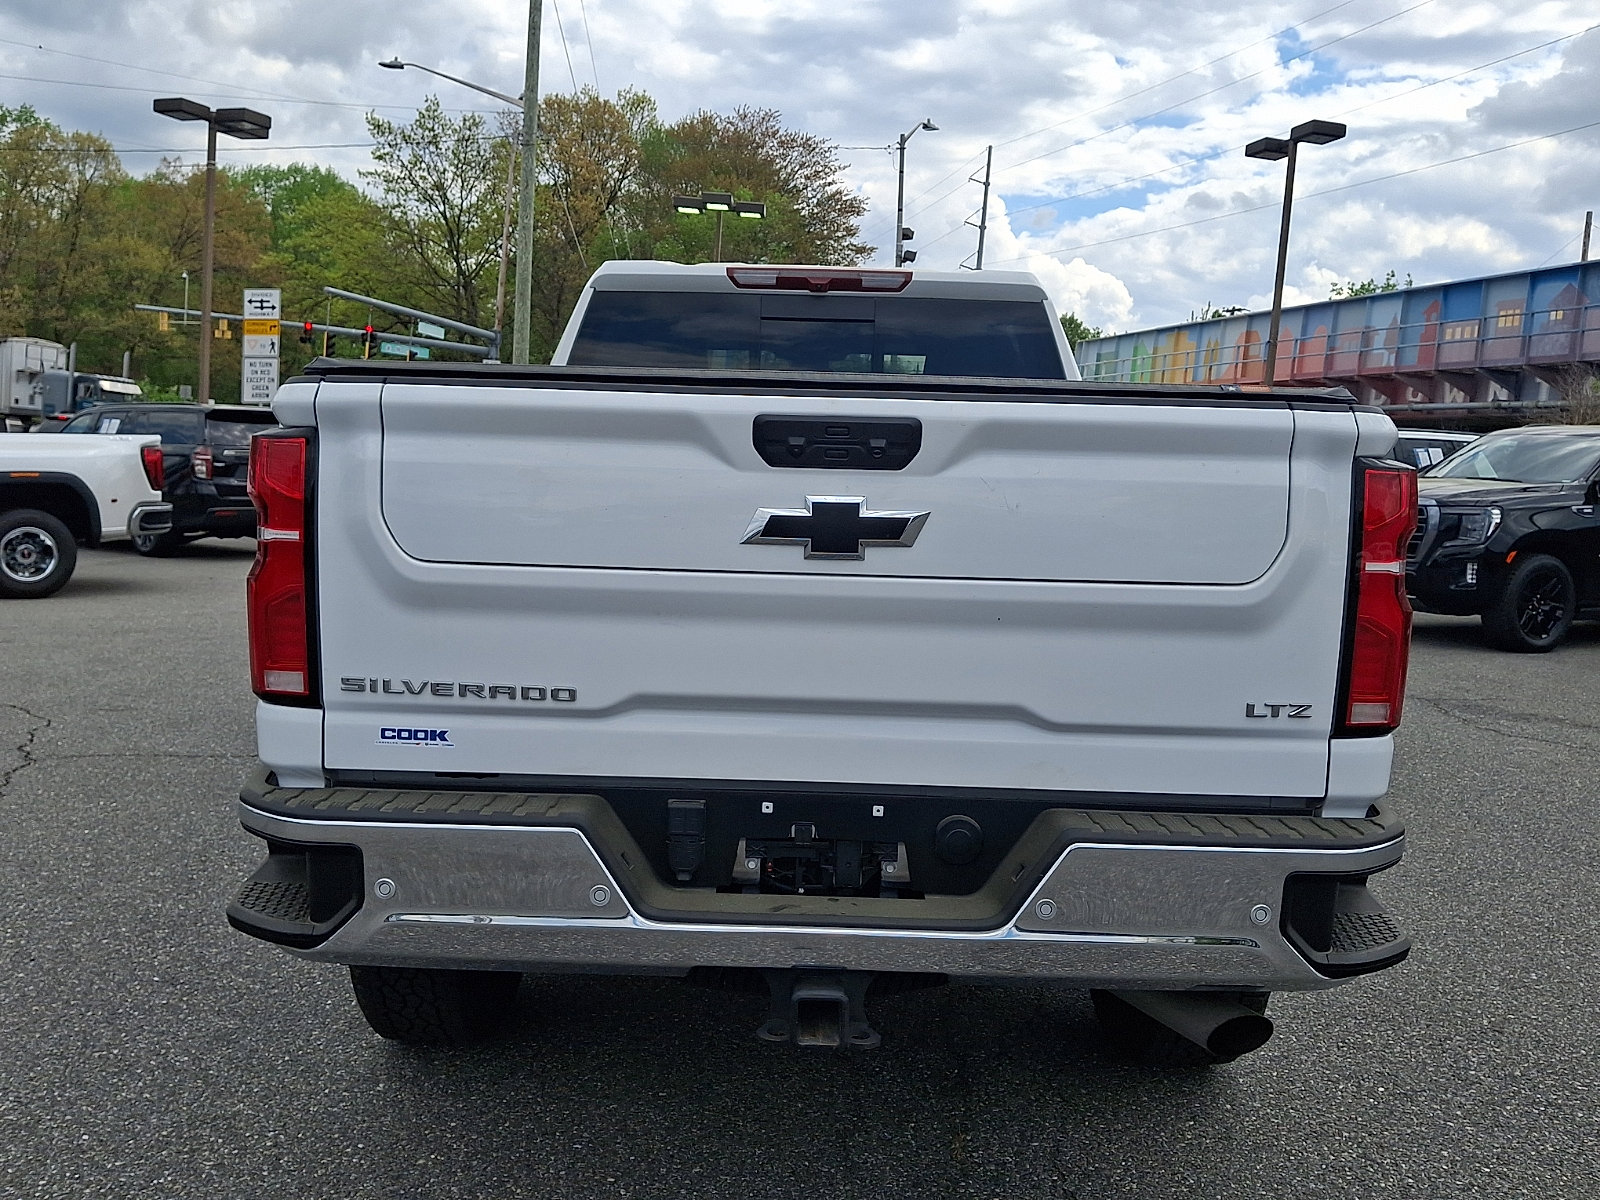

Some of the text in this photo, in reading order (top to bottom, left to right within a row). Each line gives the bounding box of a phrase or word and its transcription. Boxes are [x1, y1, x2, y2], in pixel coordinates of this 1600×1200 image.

[340, 676, 577, 702] SILVERADO
[1245, 702, 1313, 719] LTZ
[380, 727, 450, 743] COOK
